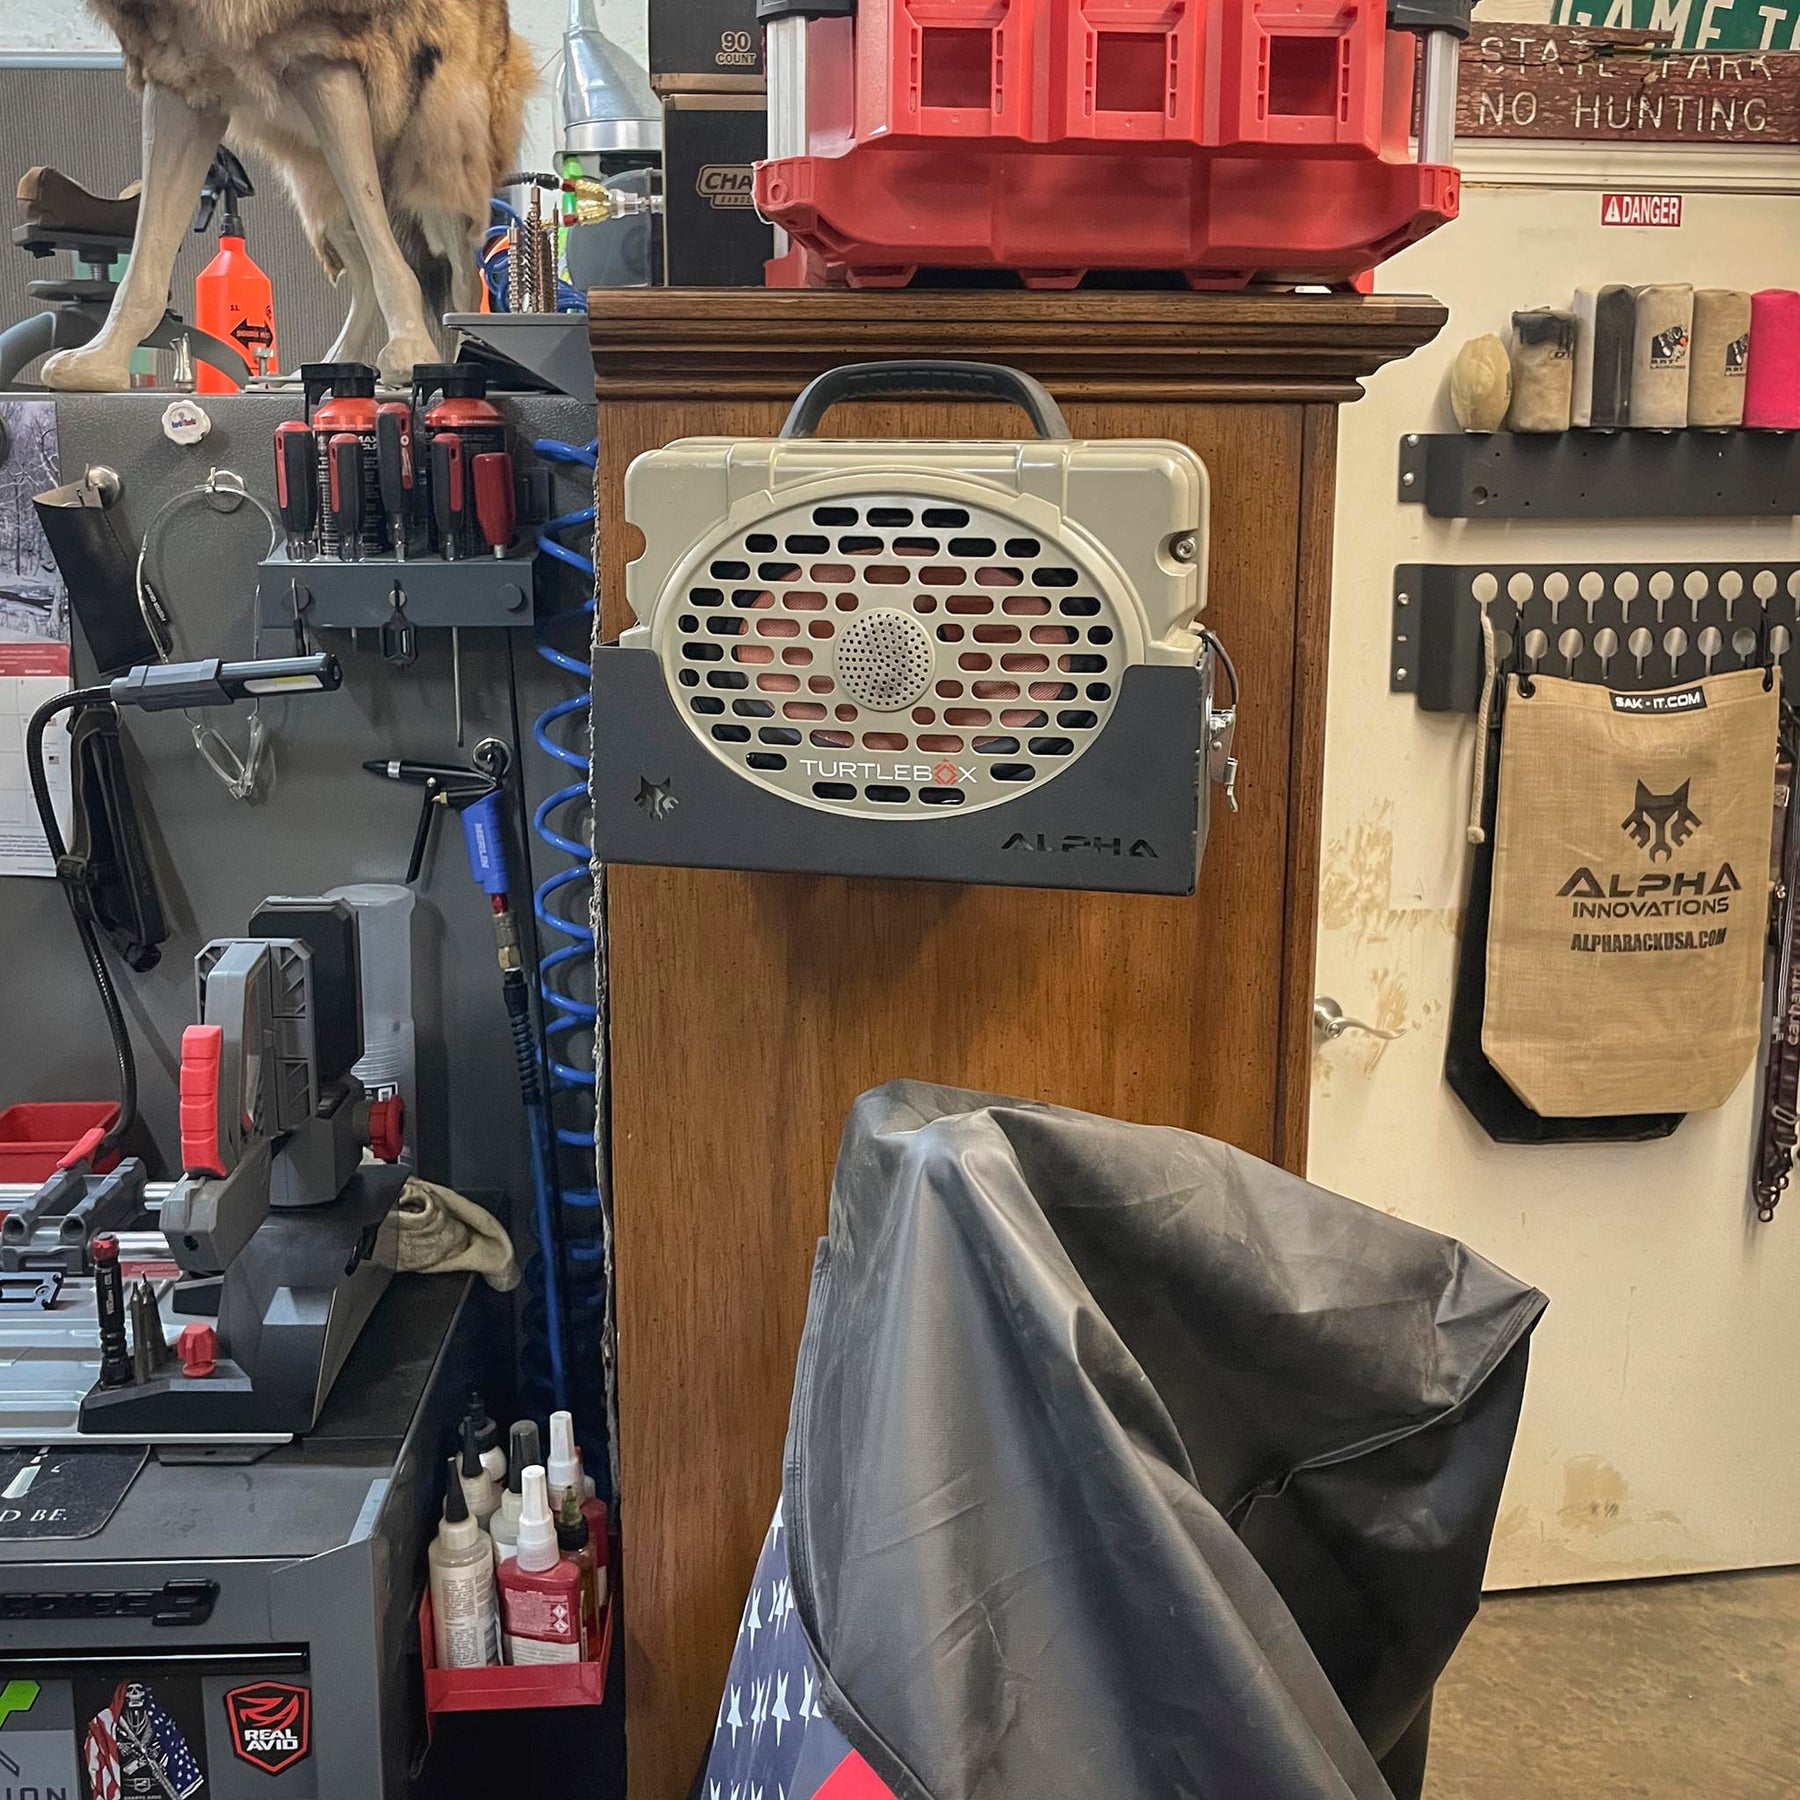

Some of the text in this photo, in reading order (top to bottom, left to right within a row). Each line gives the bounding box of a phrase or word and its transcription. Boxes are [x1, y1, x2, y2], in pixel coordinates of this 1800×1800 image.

[1758, 5, 1800, 50] T
[721, 31, 751, 52] 90
[716, 52, 757, 65] COUNT
[1479, 92, 1768, 132] NO HUNTING
[1622, 196, 1679, 224] DANGER
[1614, 696, 1643, 709] SAK
[799, 758, 978, 786] TURTLEBOX
[1001, 832, 1159, 859] ALPHA
[1555, 862, 1742, 898] ALPHA
[1572, 896, 1730, 919] INNOVATIONS
[1570, 927, 1728, 953] ALPHARACKUSA.COM
[30, 1508, 67, 1522] BE.
[244, 1729, 298, 1741] REAL
[246, 1740, 299, 1752] AVID
